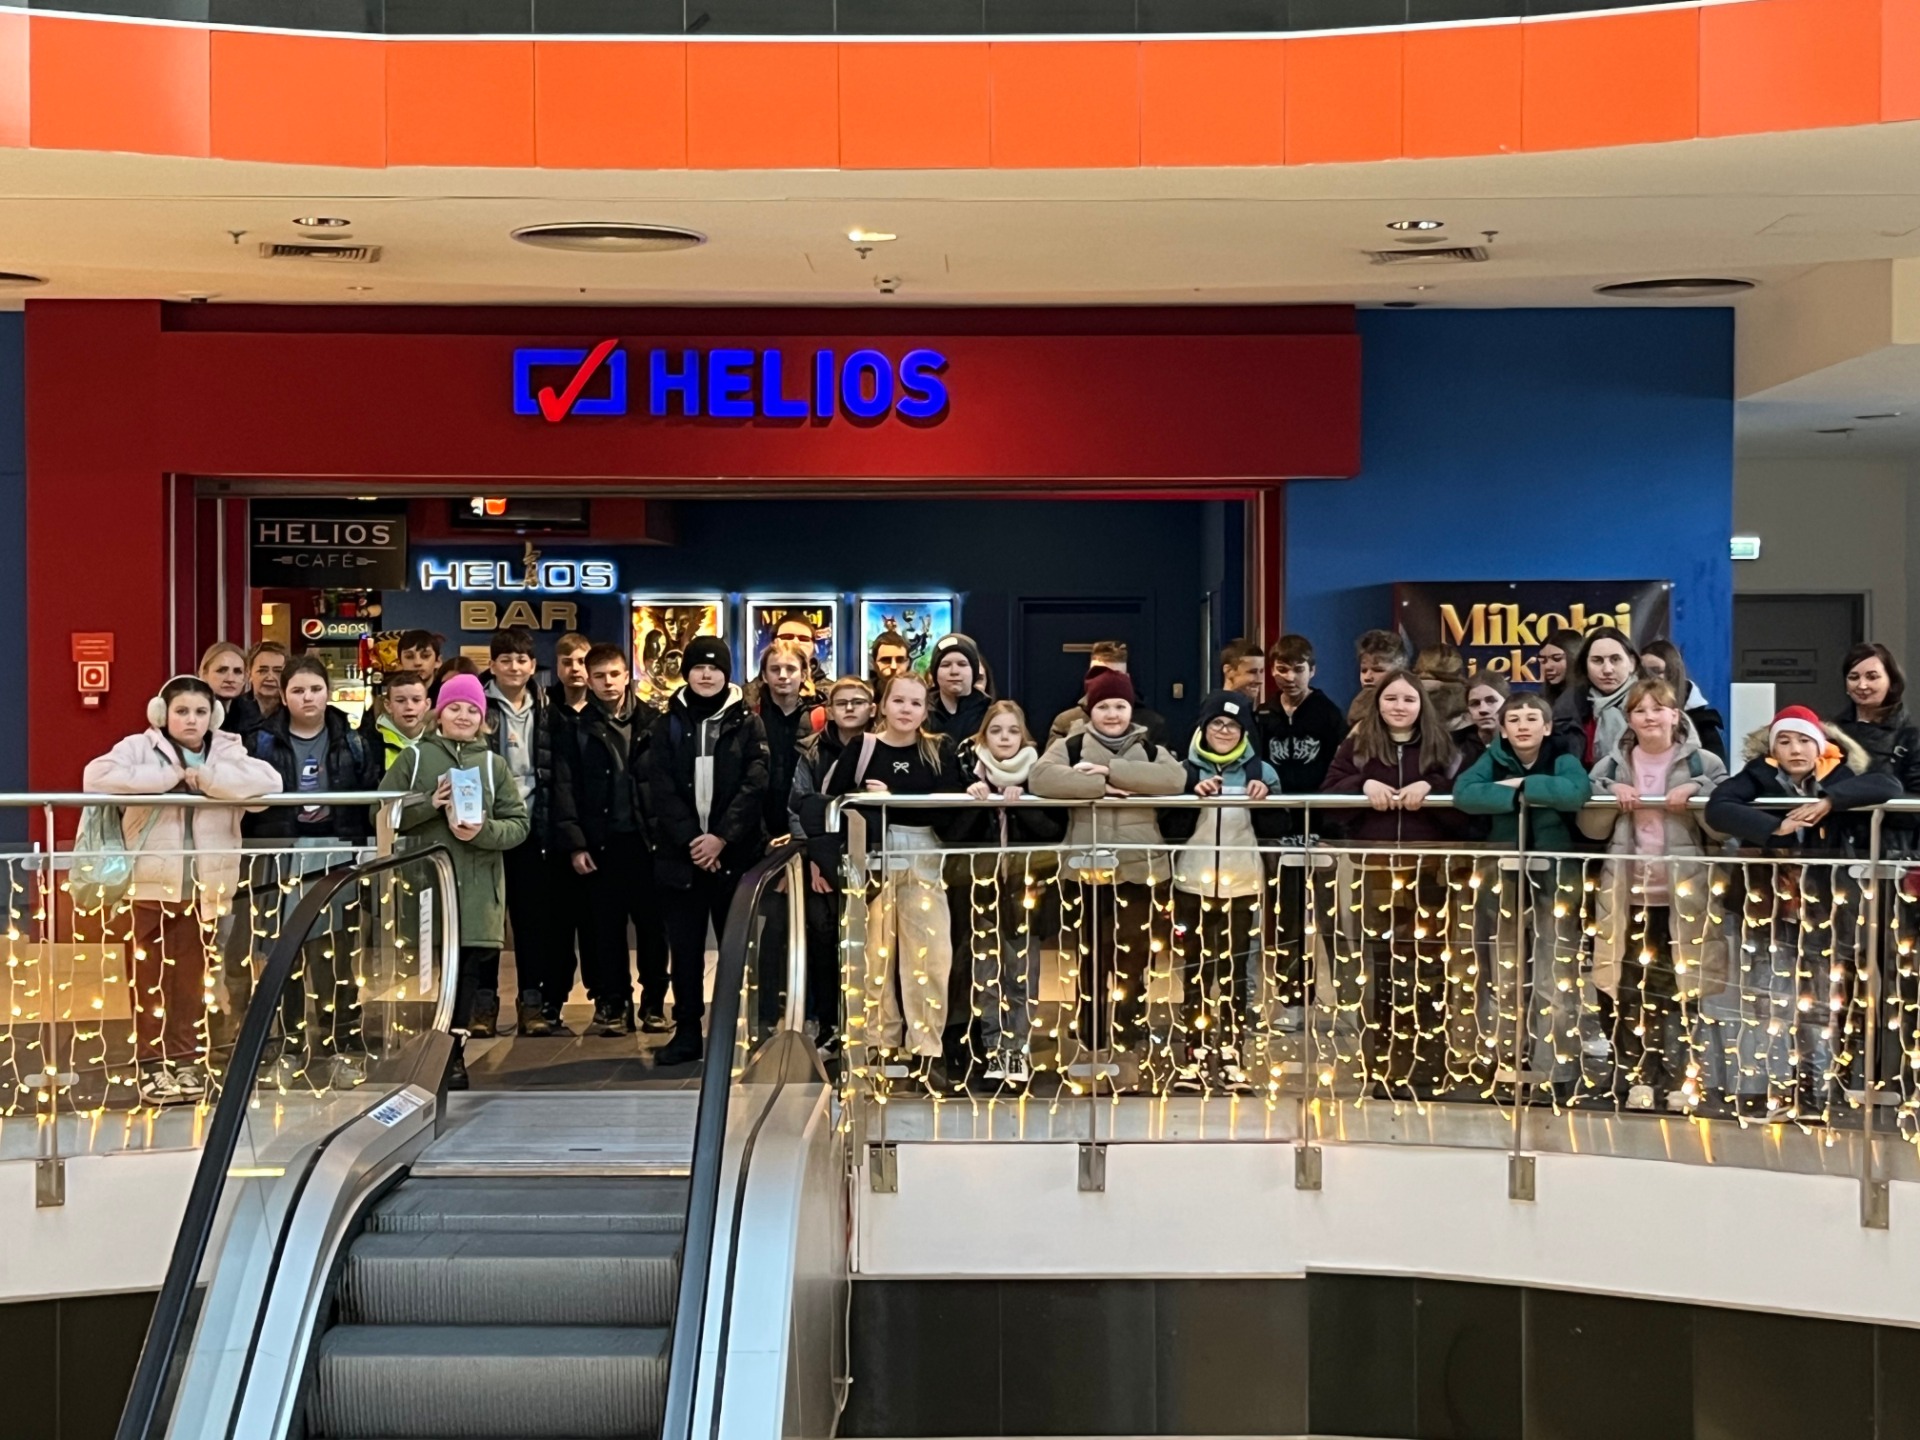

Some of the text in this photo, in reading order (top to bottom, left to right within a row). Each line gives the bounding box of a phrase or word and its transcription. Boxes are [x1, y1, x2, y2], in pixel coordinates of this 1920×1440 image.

[649, 348, 949, 419] HELIOS
[259, 523, 390, 545] HELIOS
[295, 553, 355, 568] CAFÉ
[460, 601, 578, 630] BAR
[327, 622, 369, 636] pepsi
